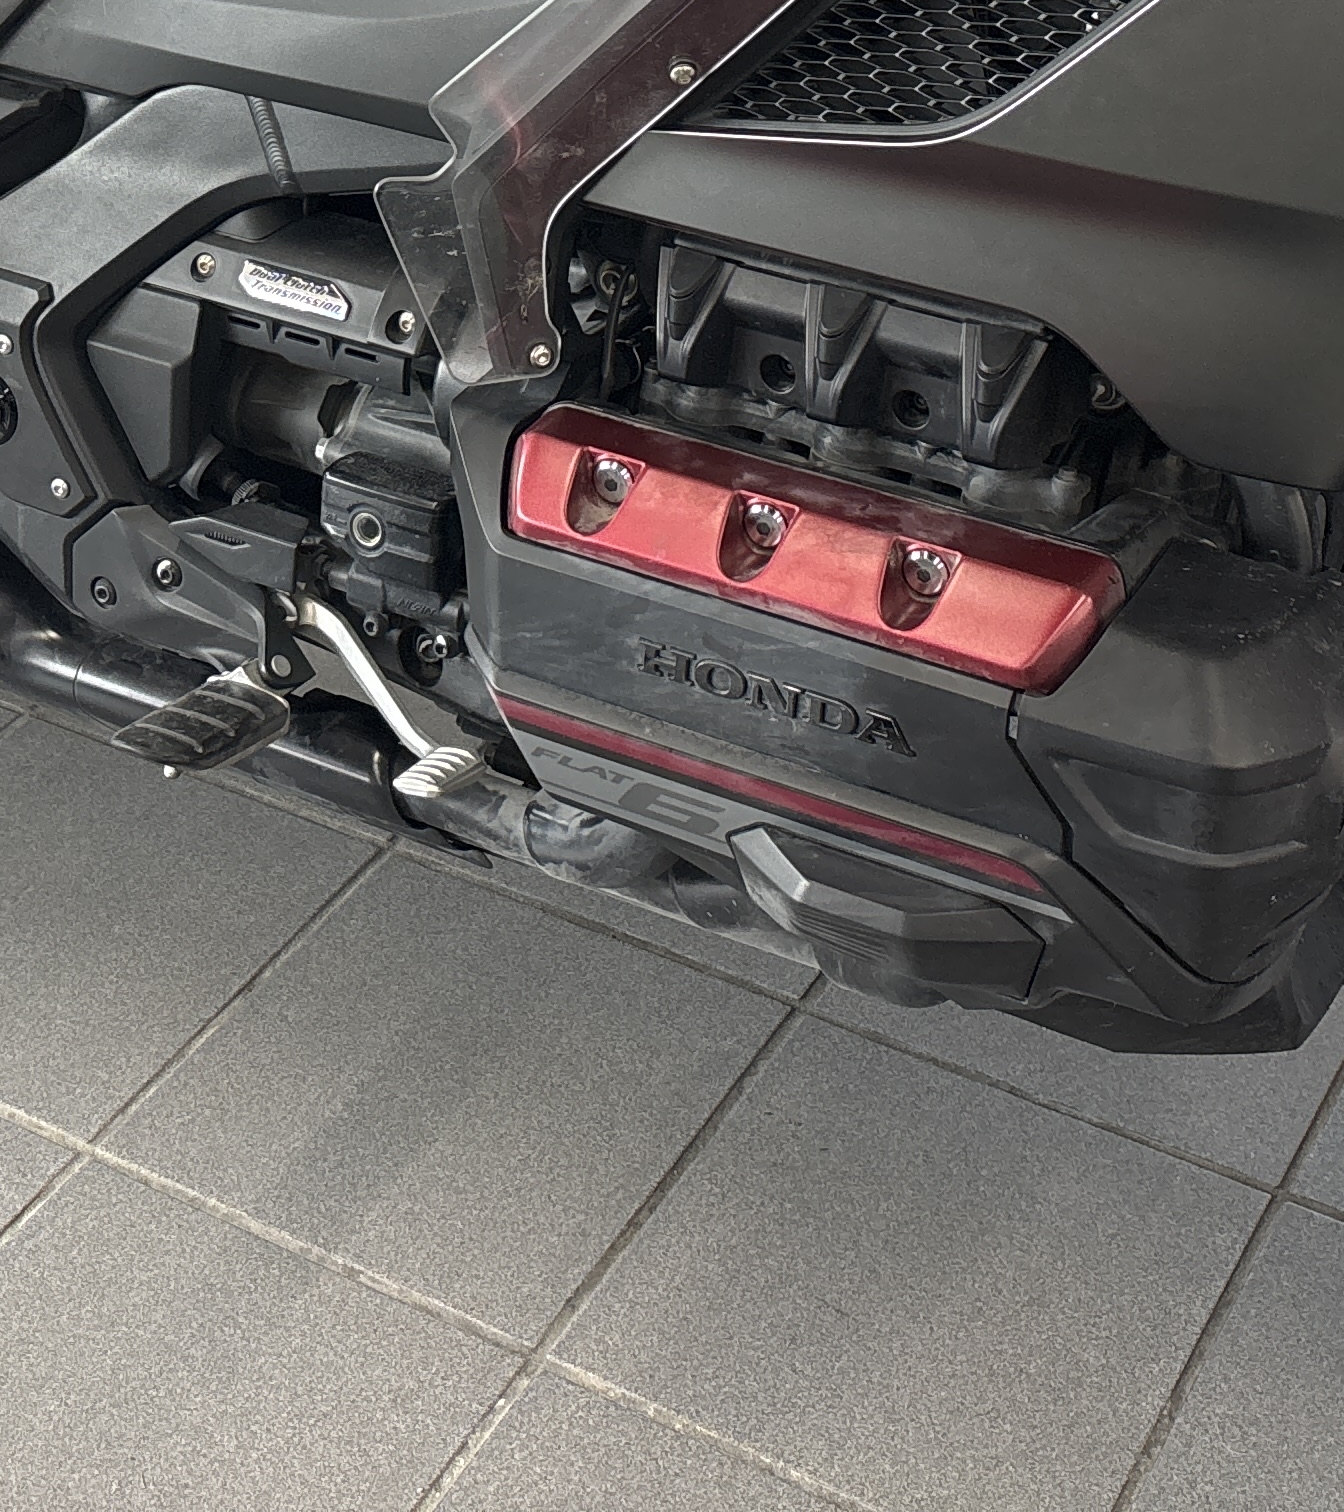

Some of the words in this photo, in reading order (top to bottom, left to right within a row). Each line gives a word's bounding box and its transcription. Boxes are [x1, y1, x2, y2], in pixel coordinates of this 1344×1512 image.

[251, 277, 342, 315] Transmission
[637, 636, 918, 758] HONDA
[531, 746, 635, 785] FLAT
[618, 781, 726, 836] 6
